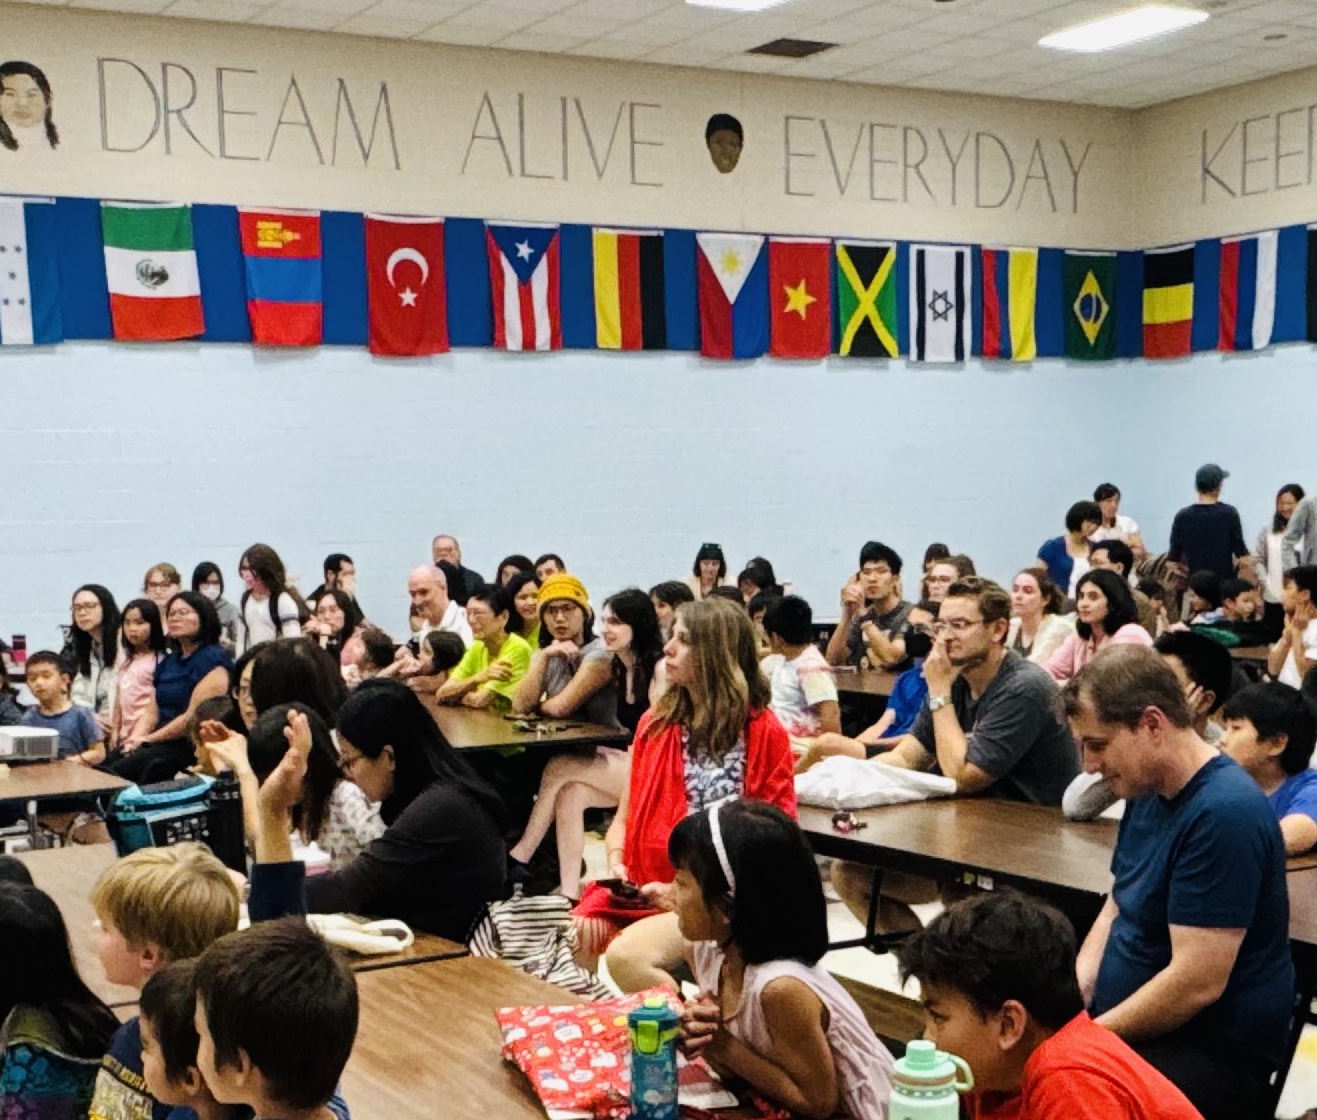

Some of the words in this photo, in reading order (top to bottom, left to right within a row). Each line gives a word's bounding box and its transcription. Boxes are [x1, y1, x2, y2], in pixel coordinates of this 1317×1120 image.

[97, 56, 403, 171] DREAM
[460, 90, 666, 188] ALIVE
[783, 114, 1093, 215] EVERYDAY
